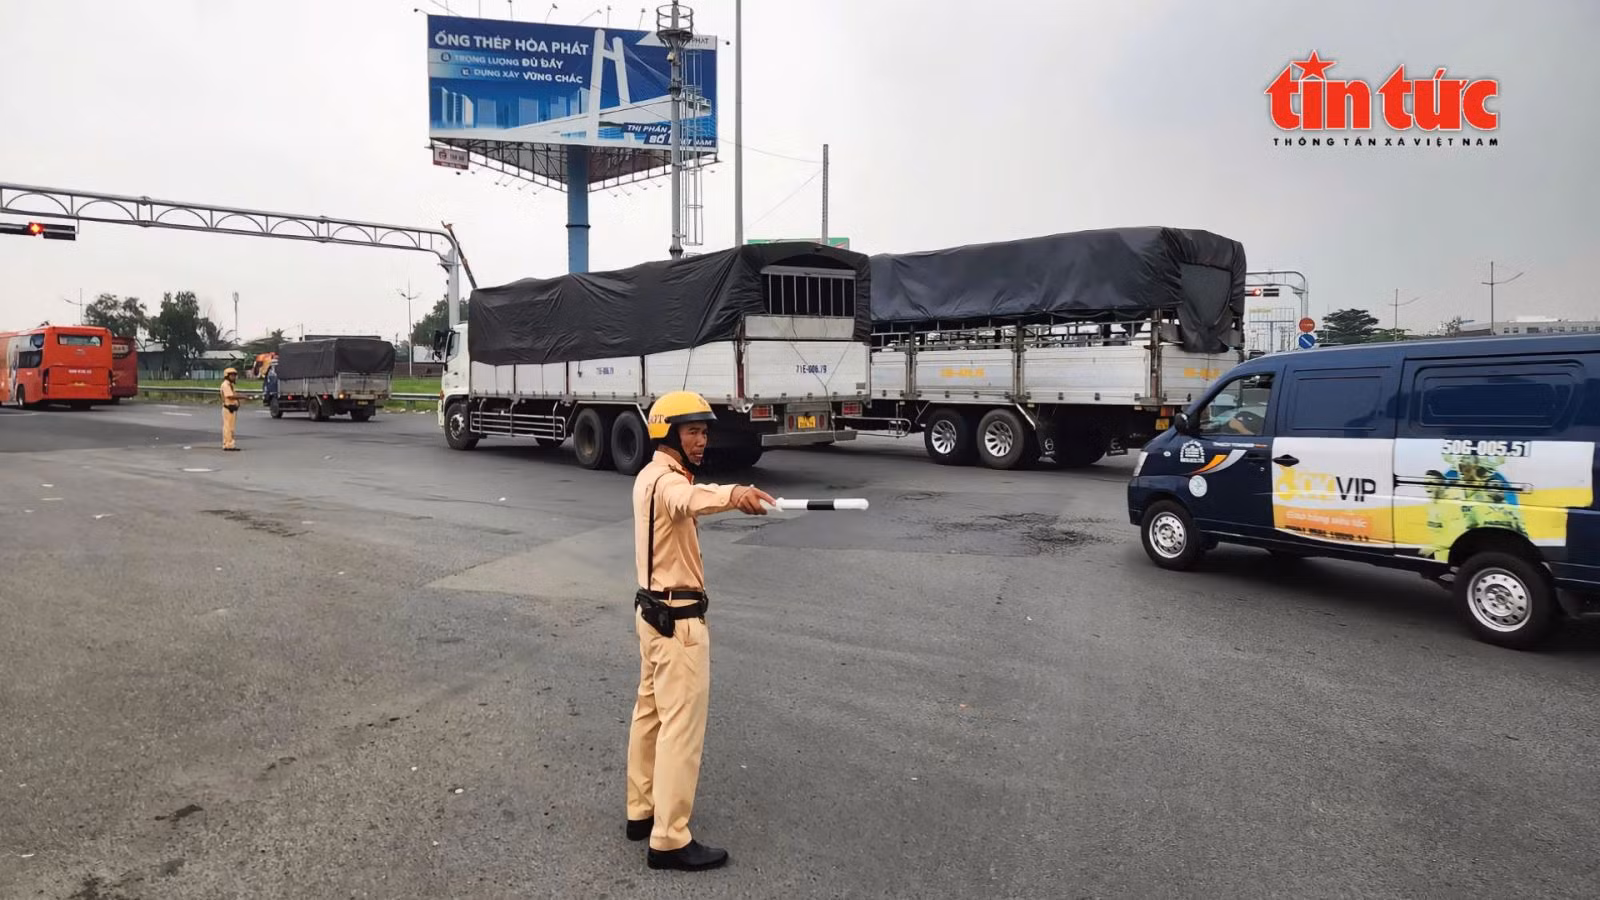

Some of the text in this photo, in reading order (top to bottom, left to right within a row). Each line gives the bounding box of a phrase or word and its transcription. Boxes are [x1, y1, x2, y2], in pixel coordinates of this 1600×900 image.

[435, 30, 590, 56] ỐNG THÉP HÒA PHÁT
[1441, 439, 1531, 457] 50G-005.51
